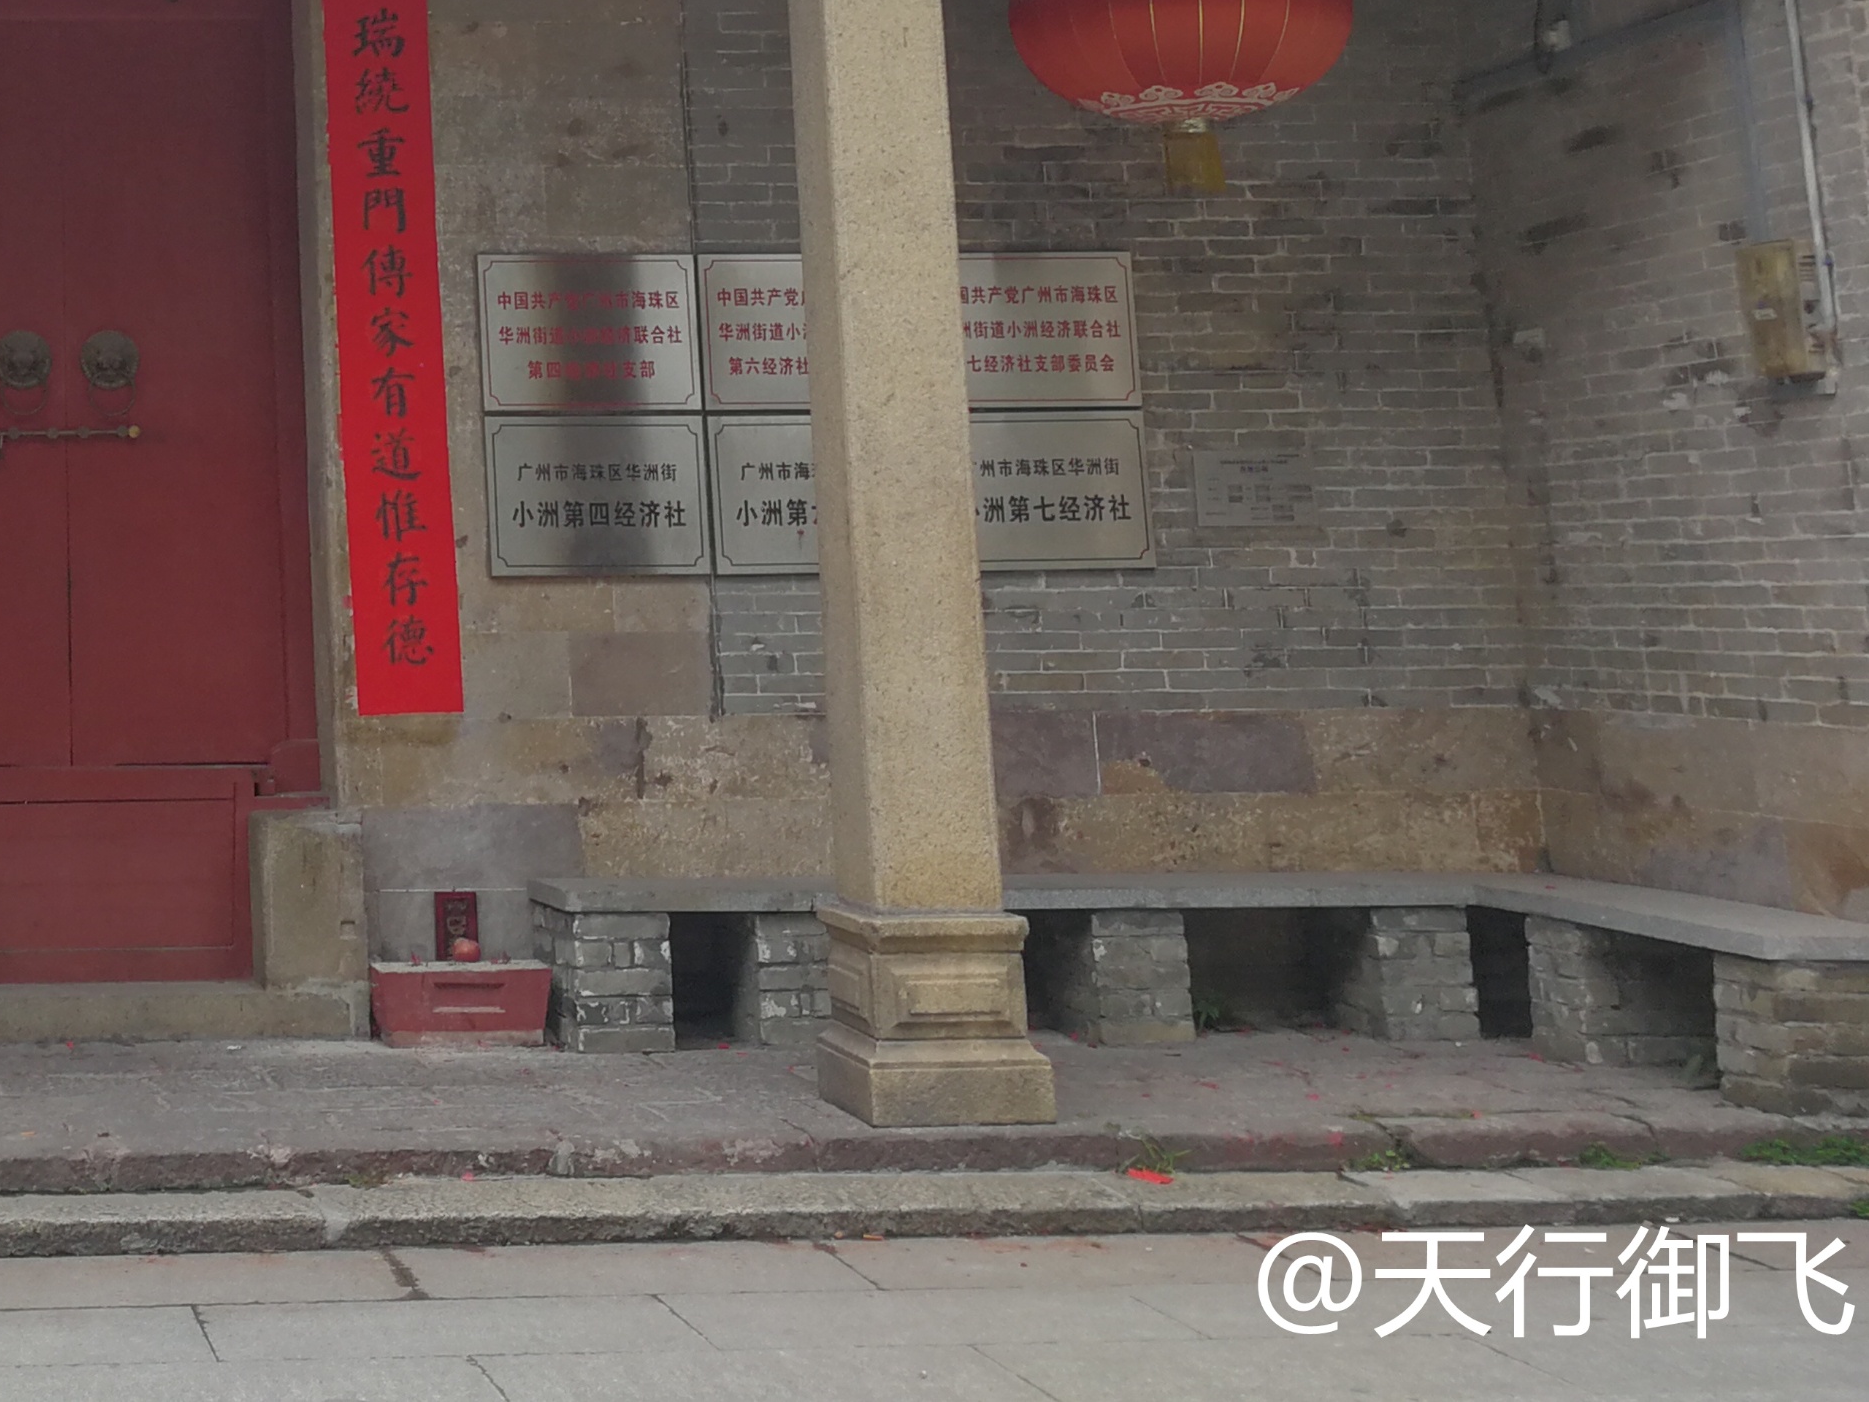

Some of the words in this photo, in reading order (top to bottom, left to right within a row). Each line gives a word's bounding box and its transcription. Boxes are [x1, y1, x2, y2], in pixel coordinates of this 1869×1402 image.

[717, 287, 806, 307] 中国共产党
[498, 325, 683, 346] 华洲街道小济联合社
[718, 322, 807, 342] 华洲街道小
[527, 360, 656, 380] 第四社支部
[517, 462, 677, 482] 广州市海珠区华洲街
[974, 457, 1119, 478] 州市海珠区华洲街
[512, 500, 687, 528] 小洲第四经济社
[736, 499, 817, 527] 小洲第
[975, 494, 1132, 523] 洲第七经济社
